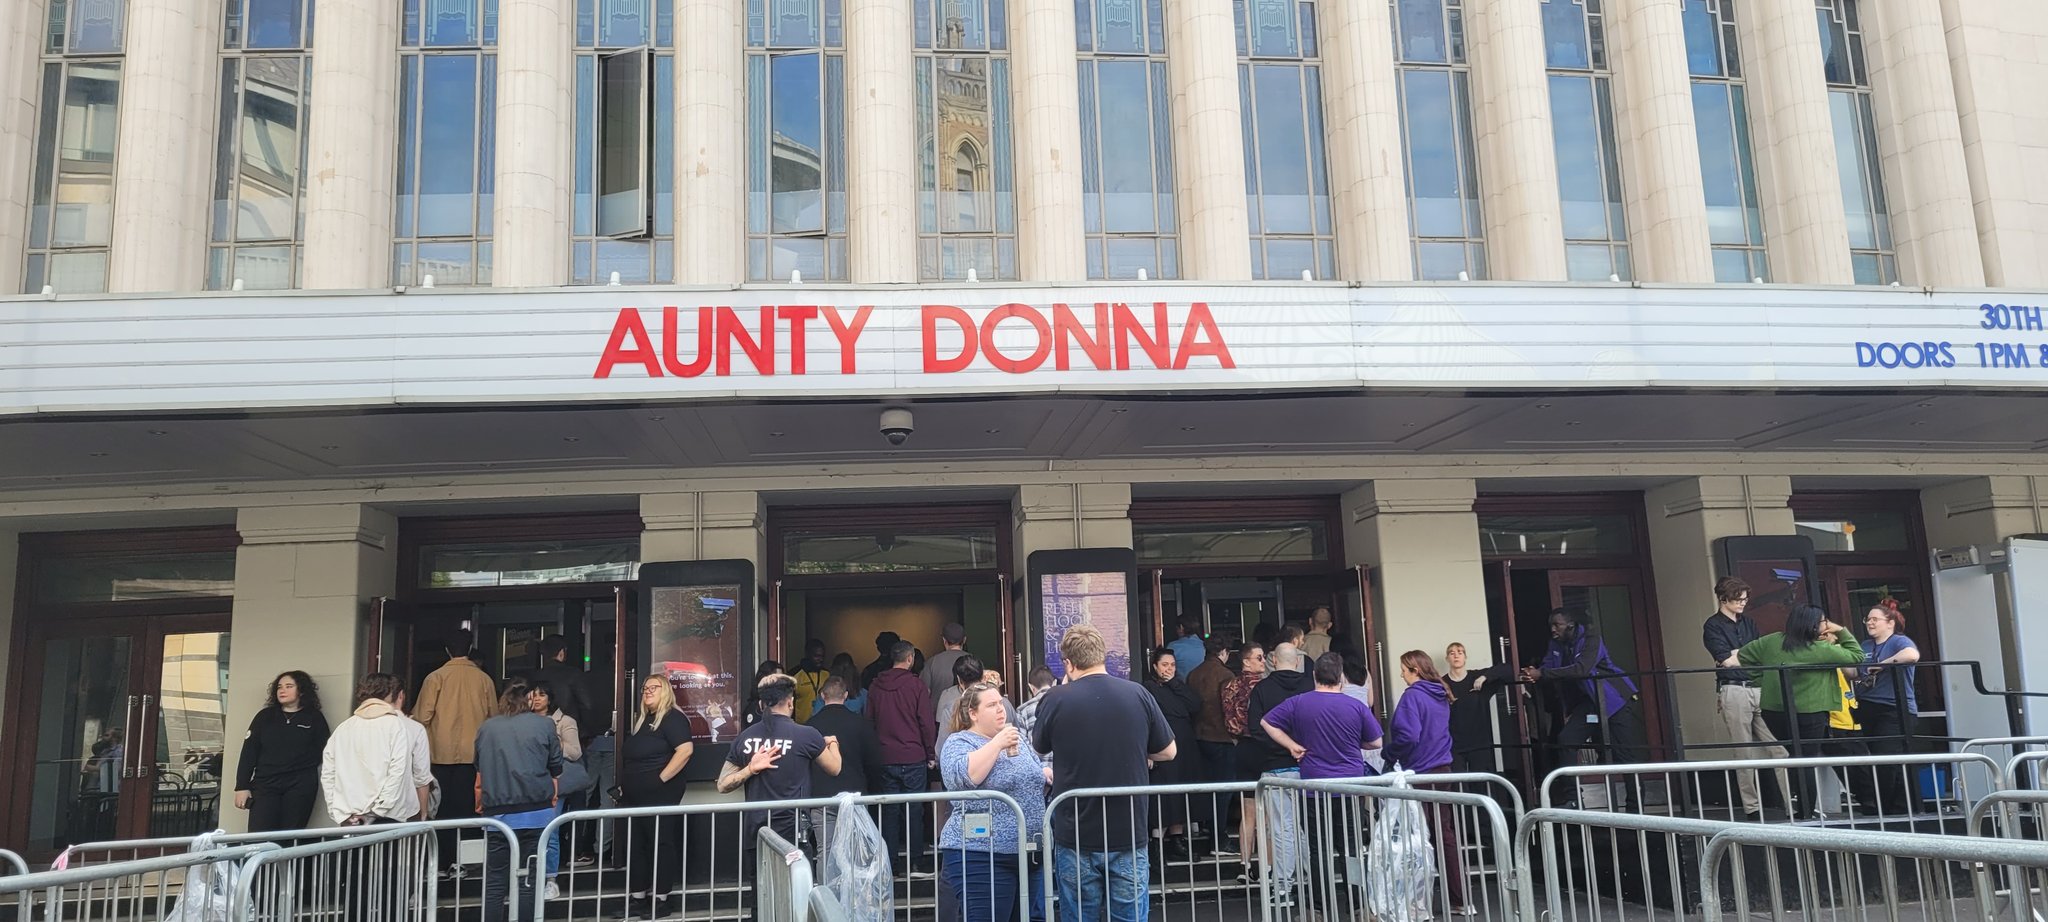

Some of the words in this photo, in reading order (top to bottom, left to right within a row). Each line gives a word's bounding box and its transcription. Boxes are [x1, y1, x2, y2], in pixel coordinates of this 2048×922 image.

[1980, 304, 2043, 331] 30TH
[594, 305, 874, 378] AUNTY
[922, 302, 1236, 374] DONNA
[1855, 341, 1956, 369] DOORS
[1975, 342, 2031, 368] 1PM
[679, 682, 703, 690] looking
[743, 737, 793, 755] STAFF
